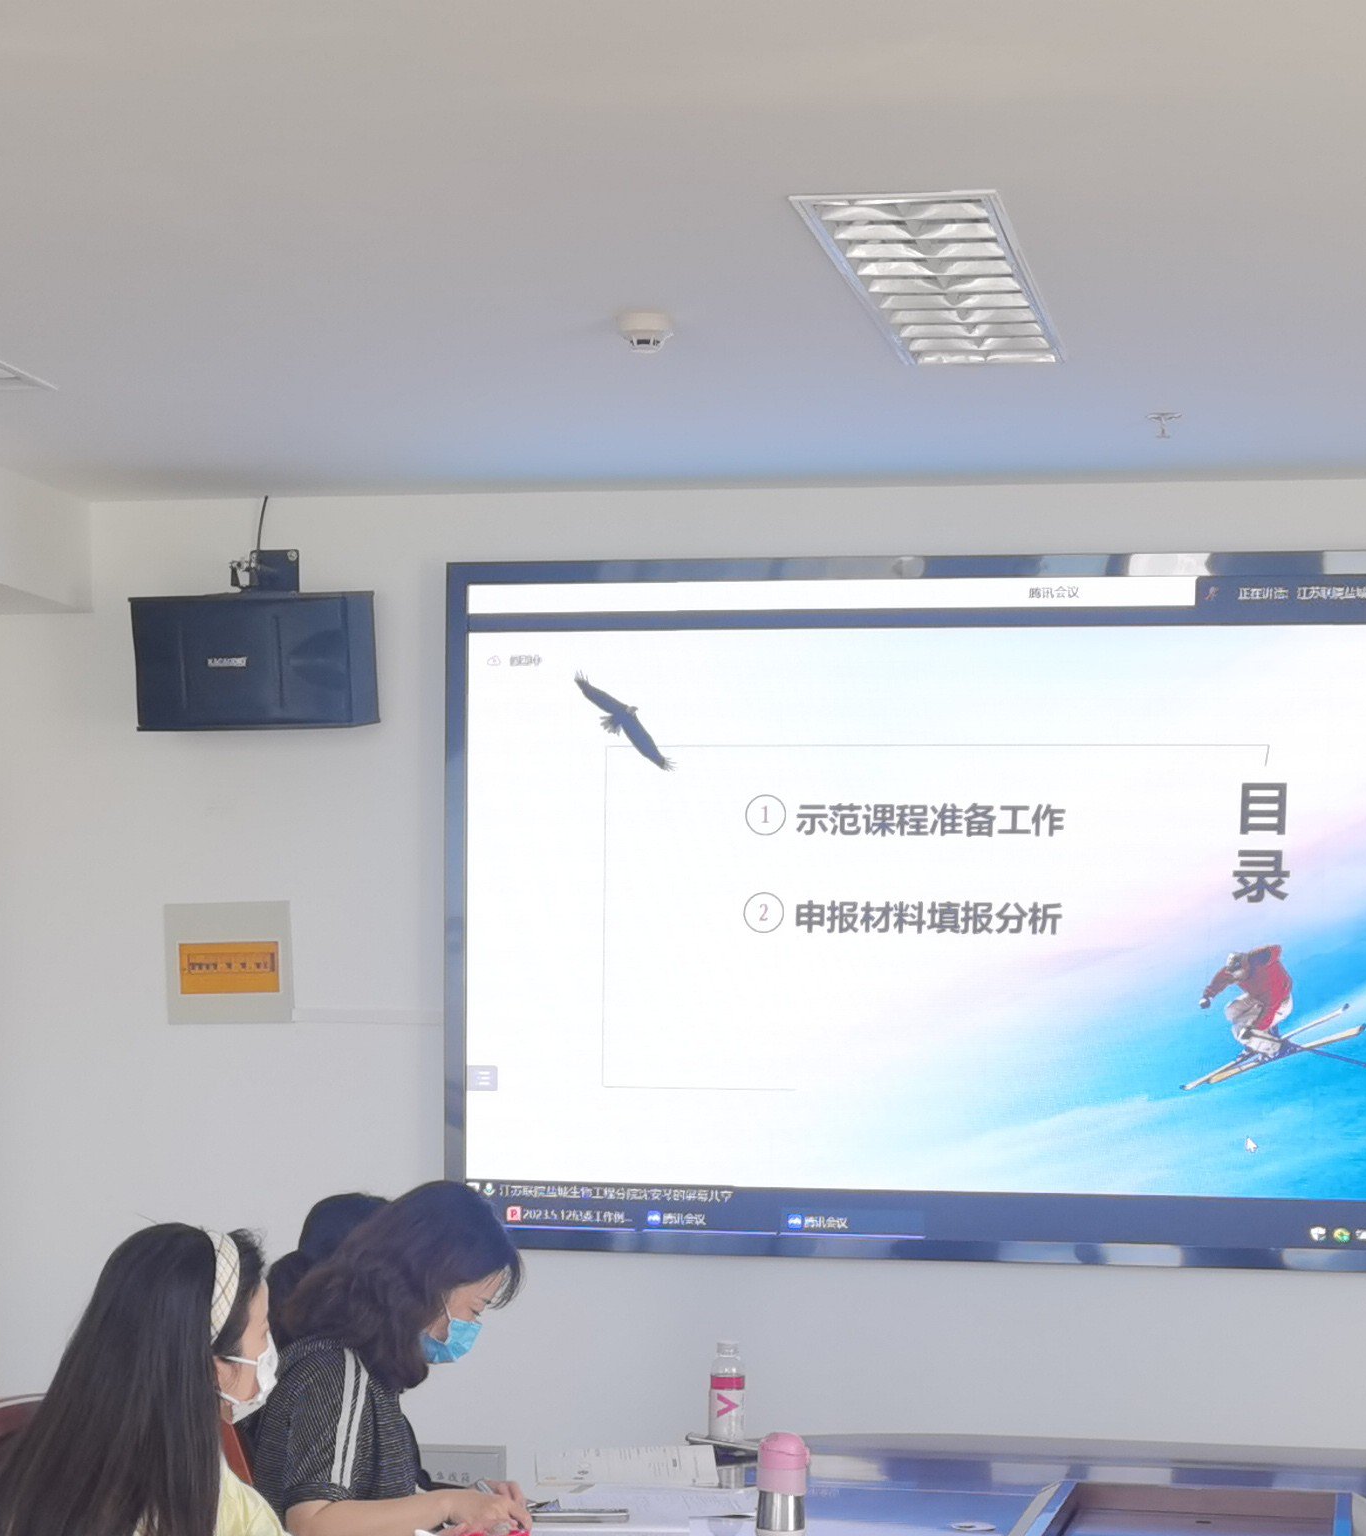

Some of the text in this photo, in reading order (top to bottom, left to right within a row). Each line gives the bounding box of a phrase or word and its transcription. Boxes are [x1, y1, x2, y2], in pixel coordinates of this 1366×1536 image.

[1029, 586, 1080, 599] 腾讯会议
[795, 802, 1066, 837] 示范课程准备工作
[795, 900, 1063, 935] 申报材料填报分析
